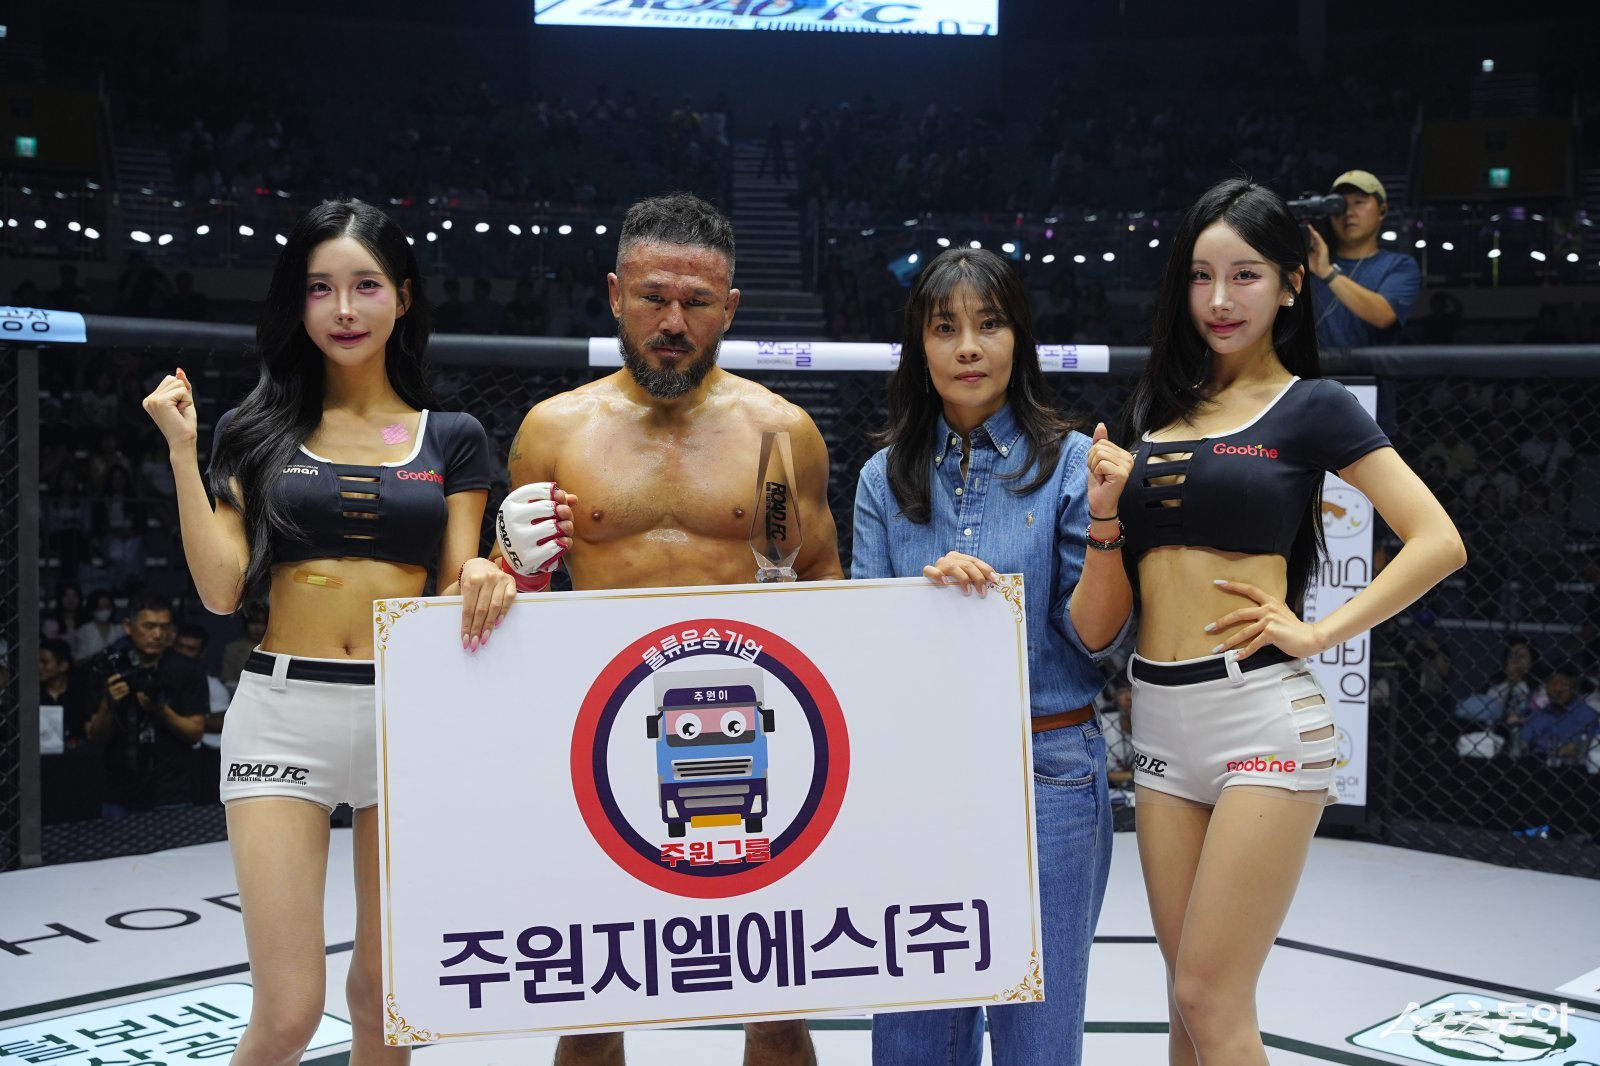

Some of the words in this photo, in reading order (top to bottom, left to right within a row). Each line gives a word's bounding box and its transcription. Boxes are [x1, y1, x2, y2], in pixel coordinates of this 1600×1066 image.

[1212, 442, 1279, 459] Goobne
[282, 466, 319, 476] uman
[771, 482, 786, 522] ROAD
[771, 523, 786, 541] FC
[227, 763, 279, 778] ROAD
[281, 766, 310, 781] FC
[1148, 757, 1167, 773] FC
[660, 837, 772, 868] 주원그룹
